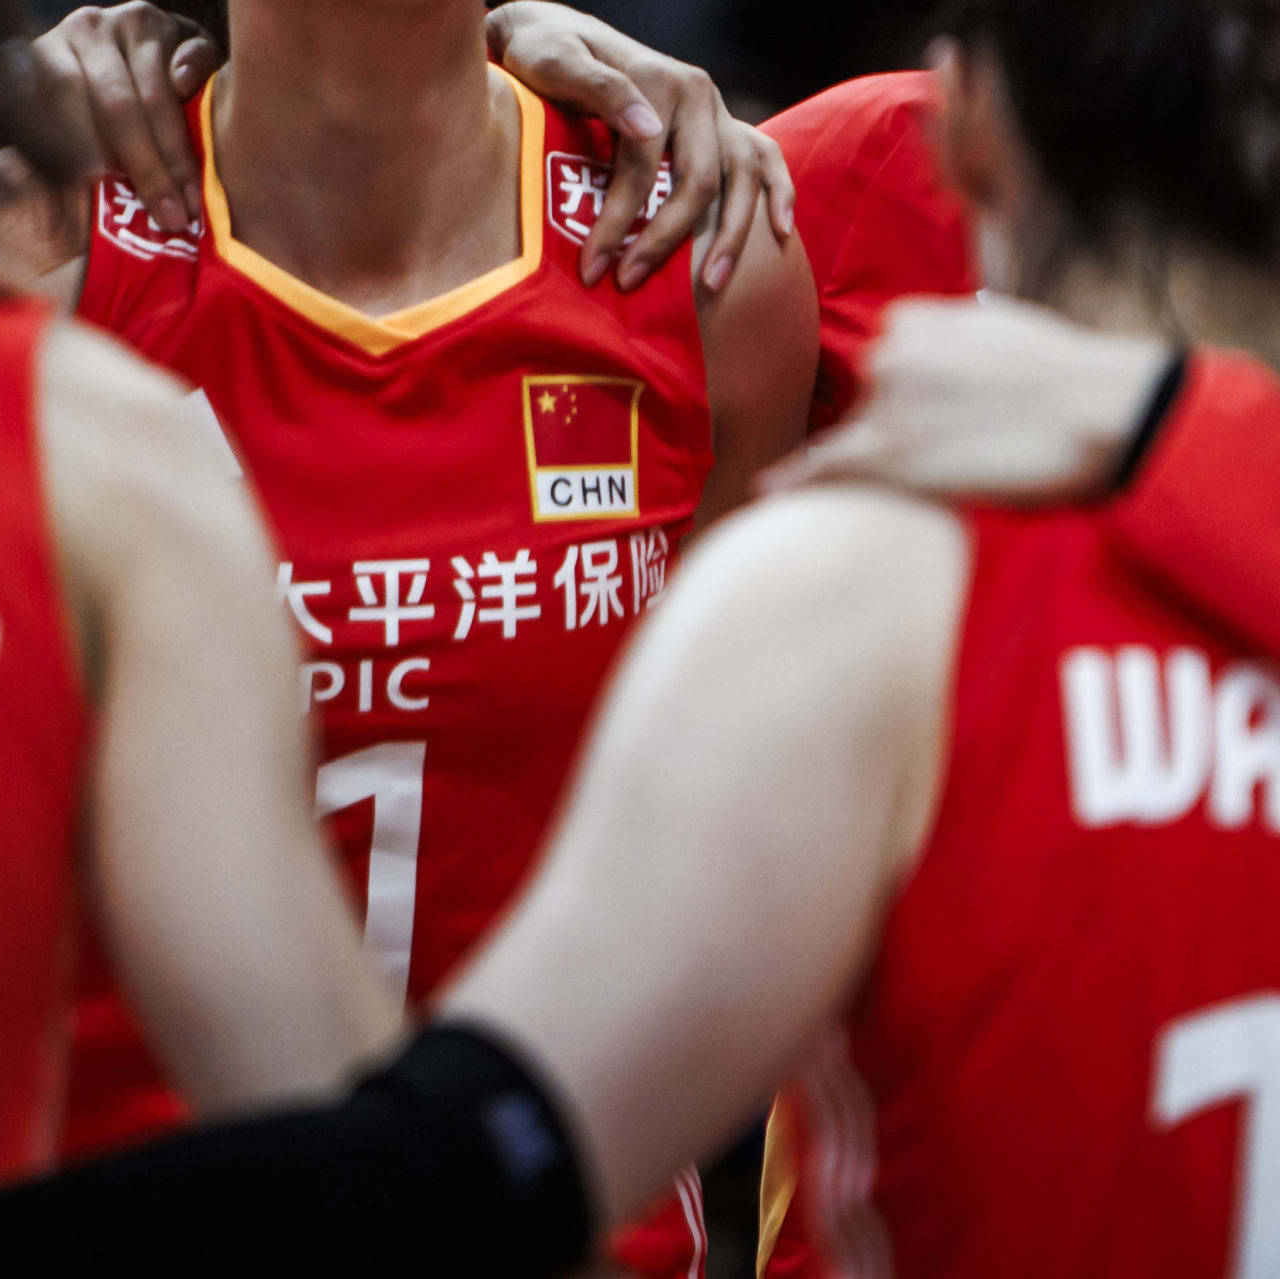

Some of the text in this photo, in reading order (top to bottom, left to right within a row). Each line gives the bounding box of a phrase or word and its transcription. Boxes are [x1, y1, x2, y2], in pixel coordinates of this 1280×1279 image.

[549, 476, 628, 508] CHN
[300, 656, 431, 716] PIC
[315, 741, 427, 1020] 1
